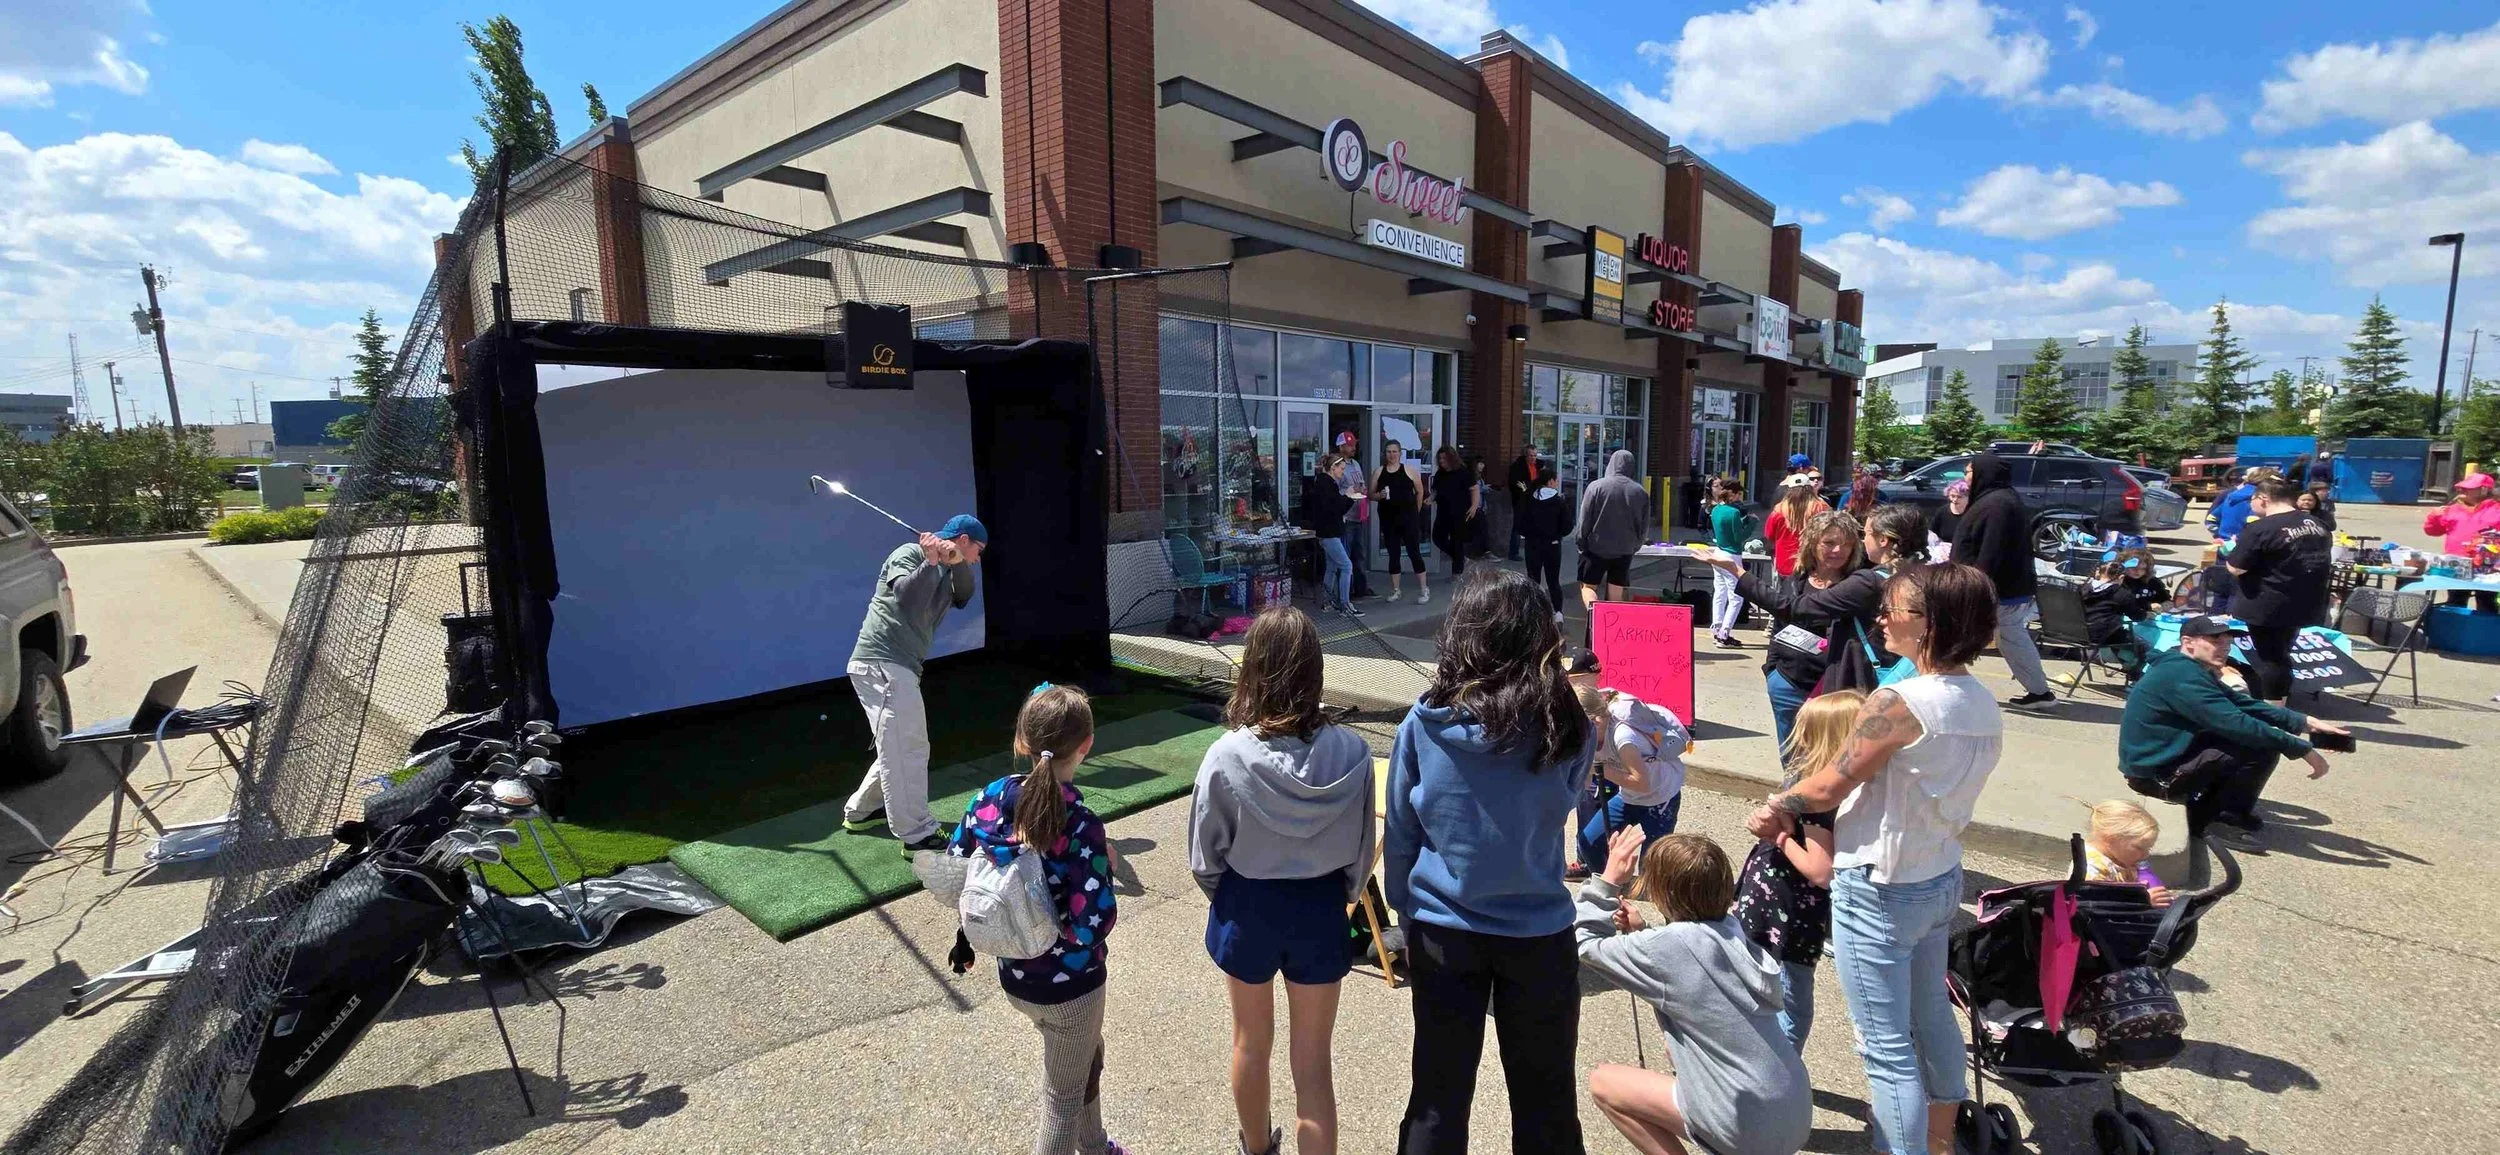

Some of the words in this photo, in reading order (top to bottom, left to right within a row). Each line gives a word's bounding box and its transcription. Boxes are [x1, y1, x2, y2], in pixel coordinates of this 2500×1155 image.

[1373, 141, 1467, 225] Sweet
[1375, 223, 1463, 265] CONVENIENCE
[1642, 236, 1689, 275] LIQUOR
[1655, 300, 1695, 333] STORE
[861, 366, 889, 374] BIRDIE
[890, 367, 907, 375] BOX
[1603, 611, 1673, 644] PARKING
[1605, 668, 1662, 692] PARTY
